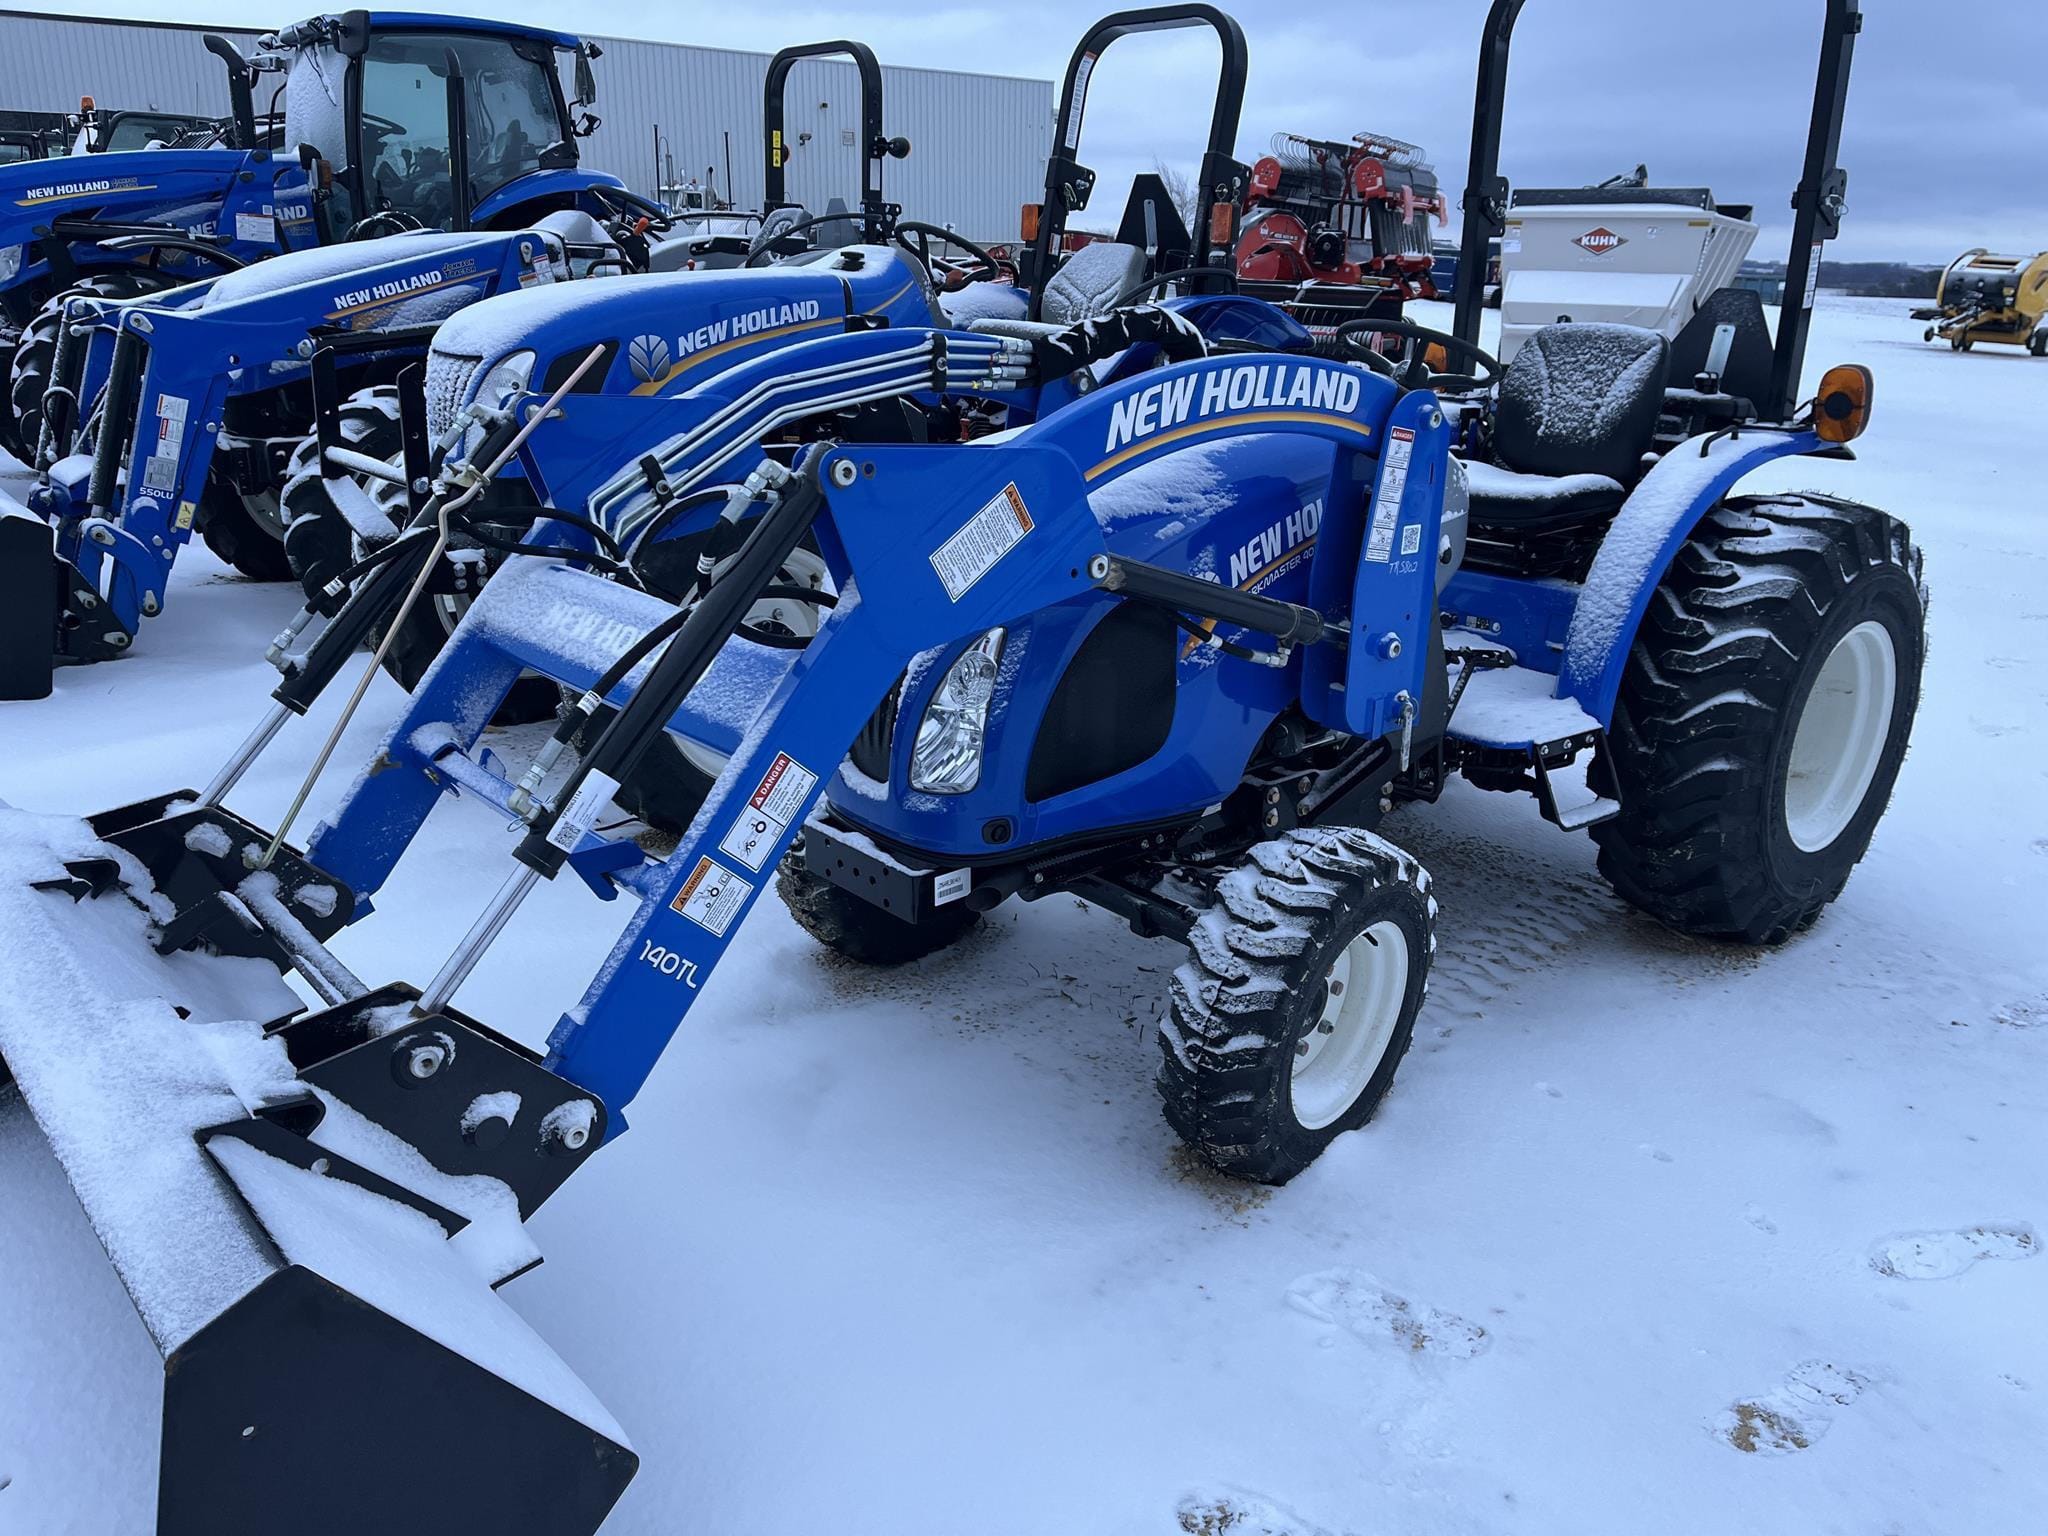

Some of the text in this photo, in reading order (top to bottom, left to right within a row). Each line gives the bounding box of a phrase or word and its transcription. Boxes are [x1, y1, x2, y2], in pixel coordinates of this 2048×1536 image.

[27, 186, 54, 199] NEW
[56, 180, 110, 195] HOLLAND
[189, 221, 217, 240] NE
[1581, 235, 1618, 246] KUHN
[334, 270, 442, 310] NEW HOLLAND
[678, 300, 820, 358] NEW HOLLAND
[1105, 366, 1360, 453] NEW HOLLAND
[1012, 497, 1030, 529] WARNING
[1230, 521, 1282, 588] NEW
[1248, 554, 1302, 594] RKMASTER
[761, 759, 786, 795] DANGER
[685, 864, 708, 898] WARNING
[640, 939, 698, 989] 140TL
